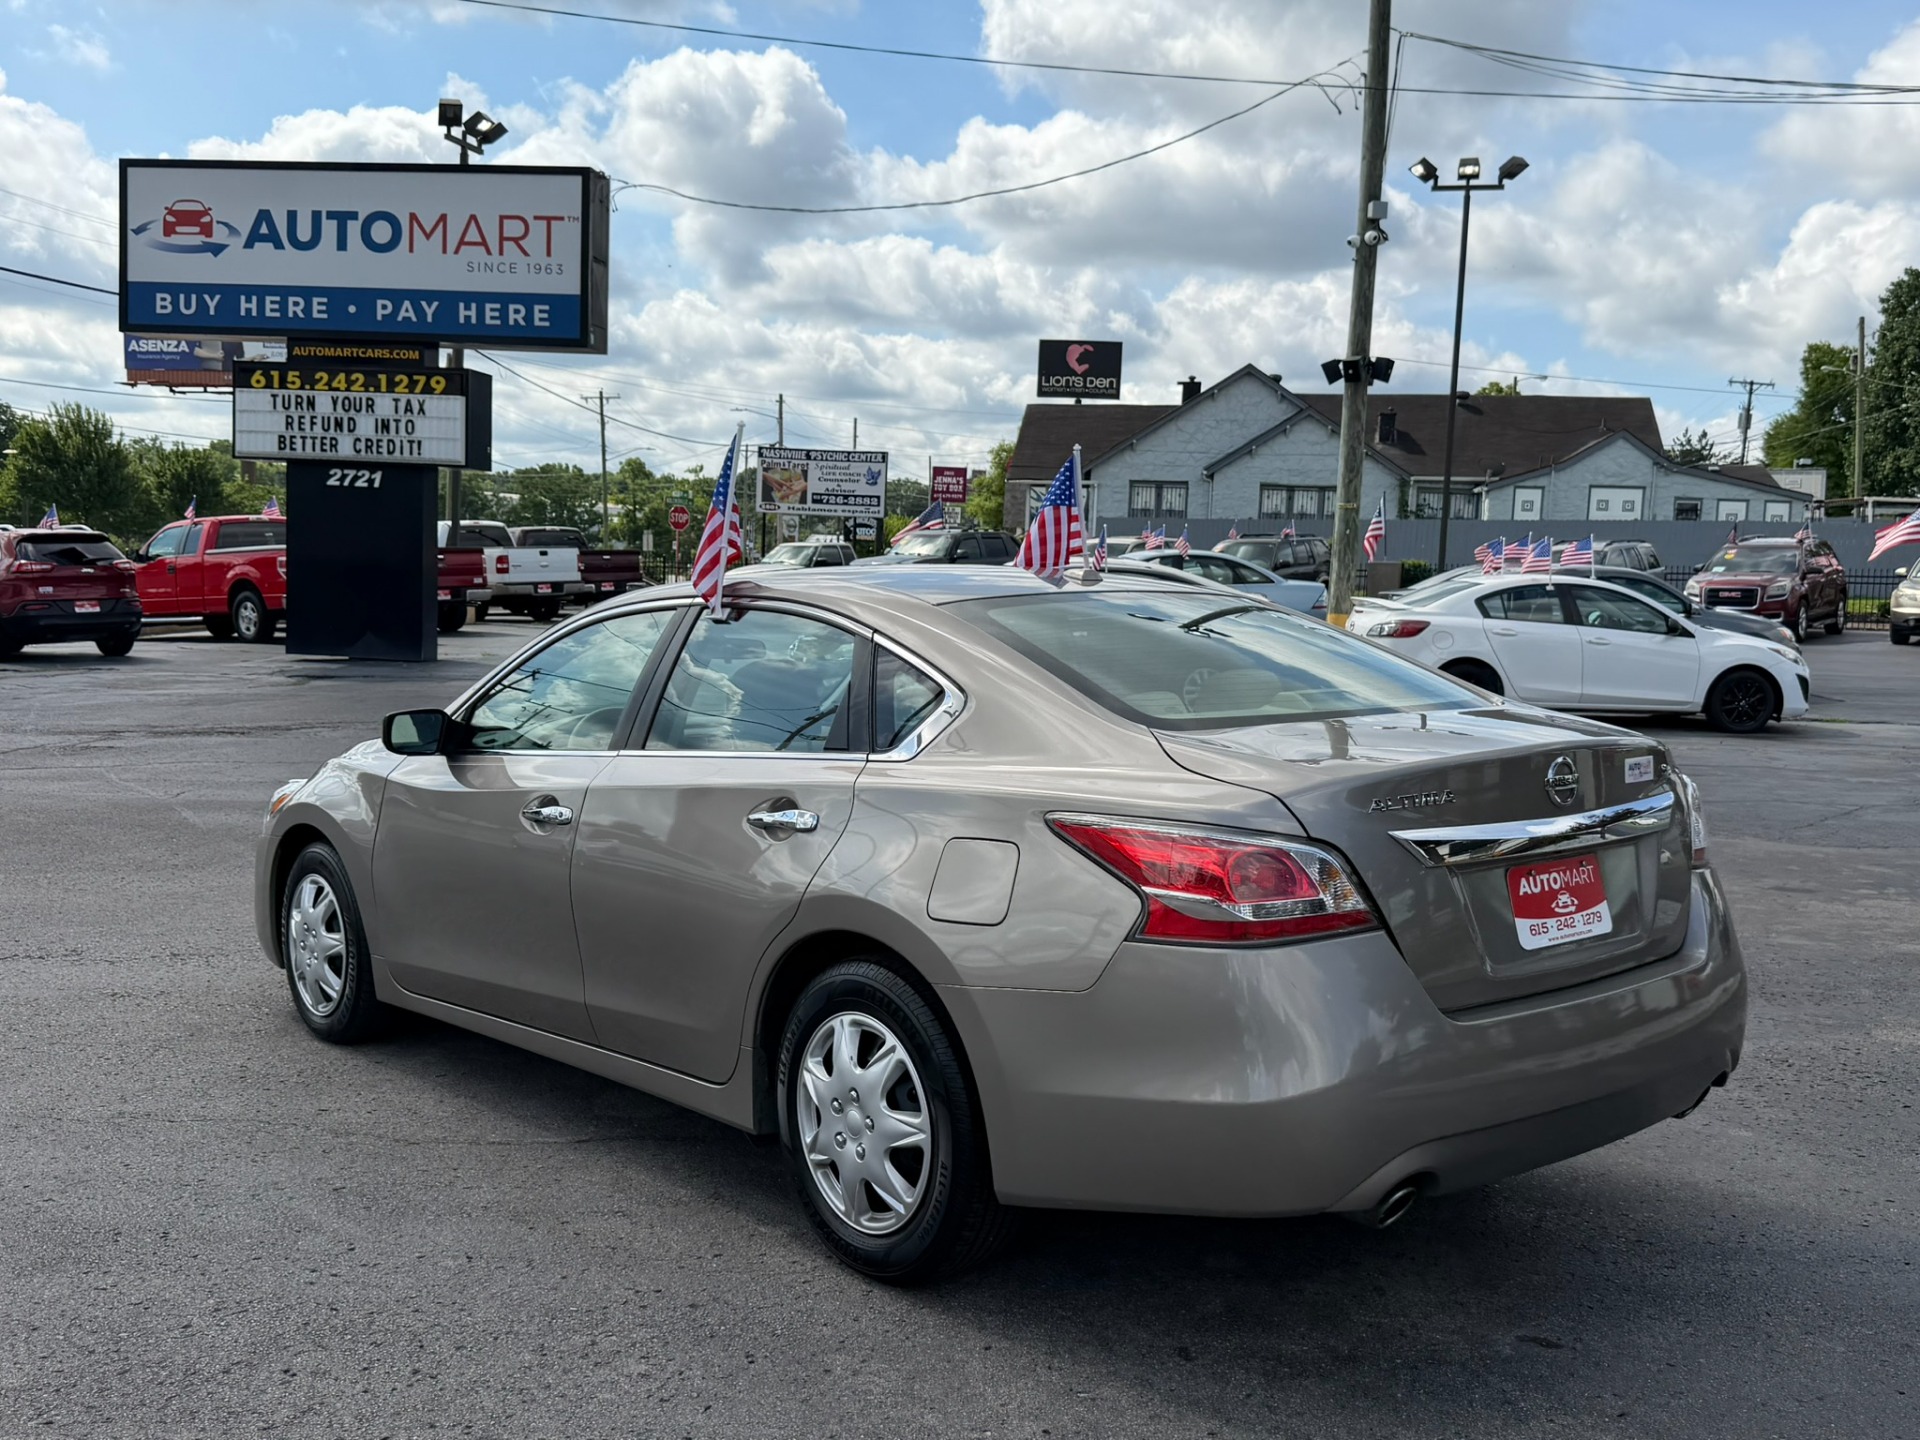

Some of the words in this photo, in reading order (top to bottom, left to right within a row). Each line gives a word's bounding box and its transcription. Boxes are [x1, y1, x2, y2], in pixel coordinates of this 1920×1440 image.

[243, 208, 564, 258] AUTOMART
[466, 260, 518, 275] SINCE
[526, 262, 564, 276] 1963
[154, 292, 222, 317] BUY
[240, 295, 329, 320] HERE
[376, 299, 440, 323] PAY
[458, 302, 551, 327] HERE
[128, 339, 190, 353] ASENZA
[292, 345, 420, 360] AUTOMARTCARS.COM
[250, 370, 447, 395] 615.242.1279
[270, 393, 316, 412] TURN
[331, 395, 375, 414] YOUR
[392, 397, 426, 416] TAX
[285, 415, 357, 433] REFUND
[375, 417, 415, 435] INTO
[278, 434, 339, 453] BETTER
[760, 459, 780, 468] Palm
[786, 460, 809, 469] Tarot
[809, 451, 848, 461] PSYCHIC
[849, 453, 884, 462] CENTER
[814, 462, 851, 471] Spiritual
[326, 468, 383, 488] 2721
[818, 476, 861, 484] Counselor
[670, 512, 689, 523] STOP
[841, 507, 880, 515] español
[1367, 789, 1457, 814] ALTIMA
[1519, 865, 1595, 896] AUTOMART
